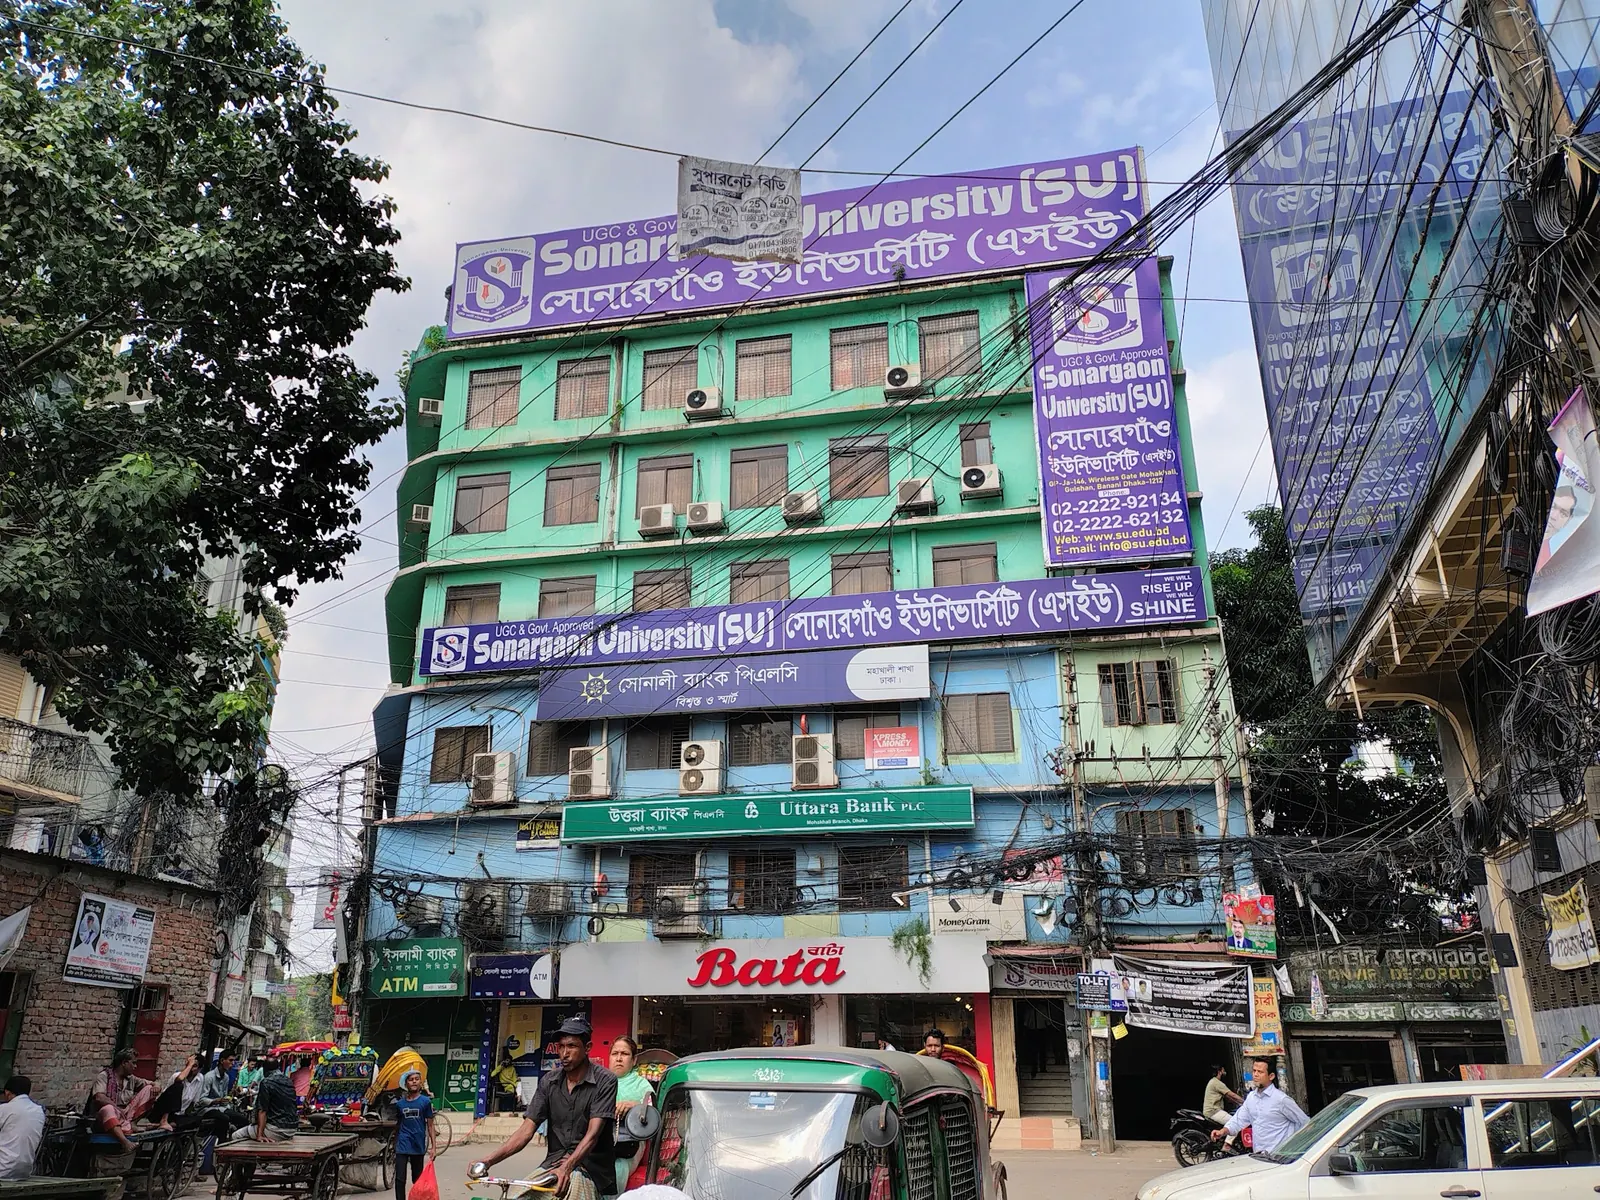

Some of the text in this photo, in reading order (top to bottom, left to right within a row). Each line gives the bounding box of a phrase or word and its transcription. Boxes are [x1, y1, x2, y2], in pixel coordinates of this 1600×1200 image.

[757, 174, 787, 192] বিডি
[749, 200, 761, 208] 25
[778, 196, 790, 205] 50
[581, 227, 622, 244] UGC
[626, 223, 639, 238] &
[644, 219, 678, 234] Gov
[540, 267, 725, 315] সোনারগাঁও
[1060, 346, 1164, 368] UGC & Govt. Approved
[1038, 357, 1167, 390] Sonargaon
[1047, 417, 1172, 452] সোনারগাঁও
[1088, 474, 1120, 484] Wireless
[1120, 472, 1138, 481] Gate
[1097, 481, 1122, 490] Banani
[1051, 489, 1181, 518] 02-2222-92134
[1052, 508, 1184, 534] 02-2222-62132
[1054, 526, 1170, 546] Web: www.su.edu.bd
[1056, 535, 1187, 556] E-mail: info@su.edu.bd
[1141, 581, 1193, 594] RISE UP
[786, 599, 893, 644] সোনারগাঁও
[896, 585, 1023, 635] ইউনিভার্সিটি
[1130, 598, 1196, 617] SHINE
[495, 619, 594, 638] UGC & Govt. Approved
[619, 661, 800, 693] সোনালী ব্যাংক পিএলসি
[866, 664, 914, 675] মহাখালী শাখা
[706, 696, 714, 705] ও
[717, 691, 739, 704] স্মার্ট
[873, 733, 907, 742] XPRESS
[881, 739, 912, 748] MONEY
[608, 806, 646, 823] উত্তরা
[650, 806, 690, 822] ব্যাংক
[780, 797, 925, 816] Uttara Bank PLC
[938, 917, 990, 928] MoneyGram
[382, 945, 458, 963] ইসলামী ব্যাংক
[808, 944, 844, 957] বাটা
[687, 947, 847, 988] Bata
[380, 977, 418, 993] ATM
[533, 973, 548, 981] ATM
[1078, 975, 1109, 986] TO-LET
